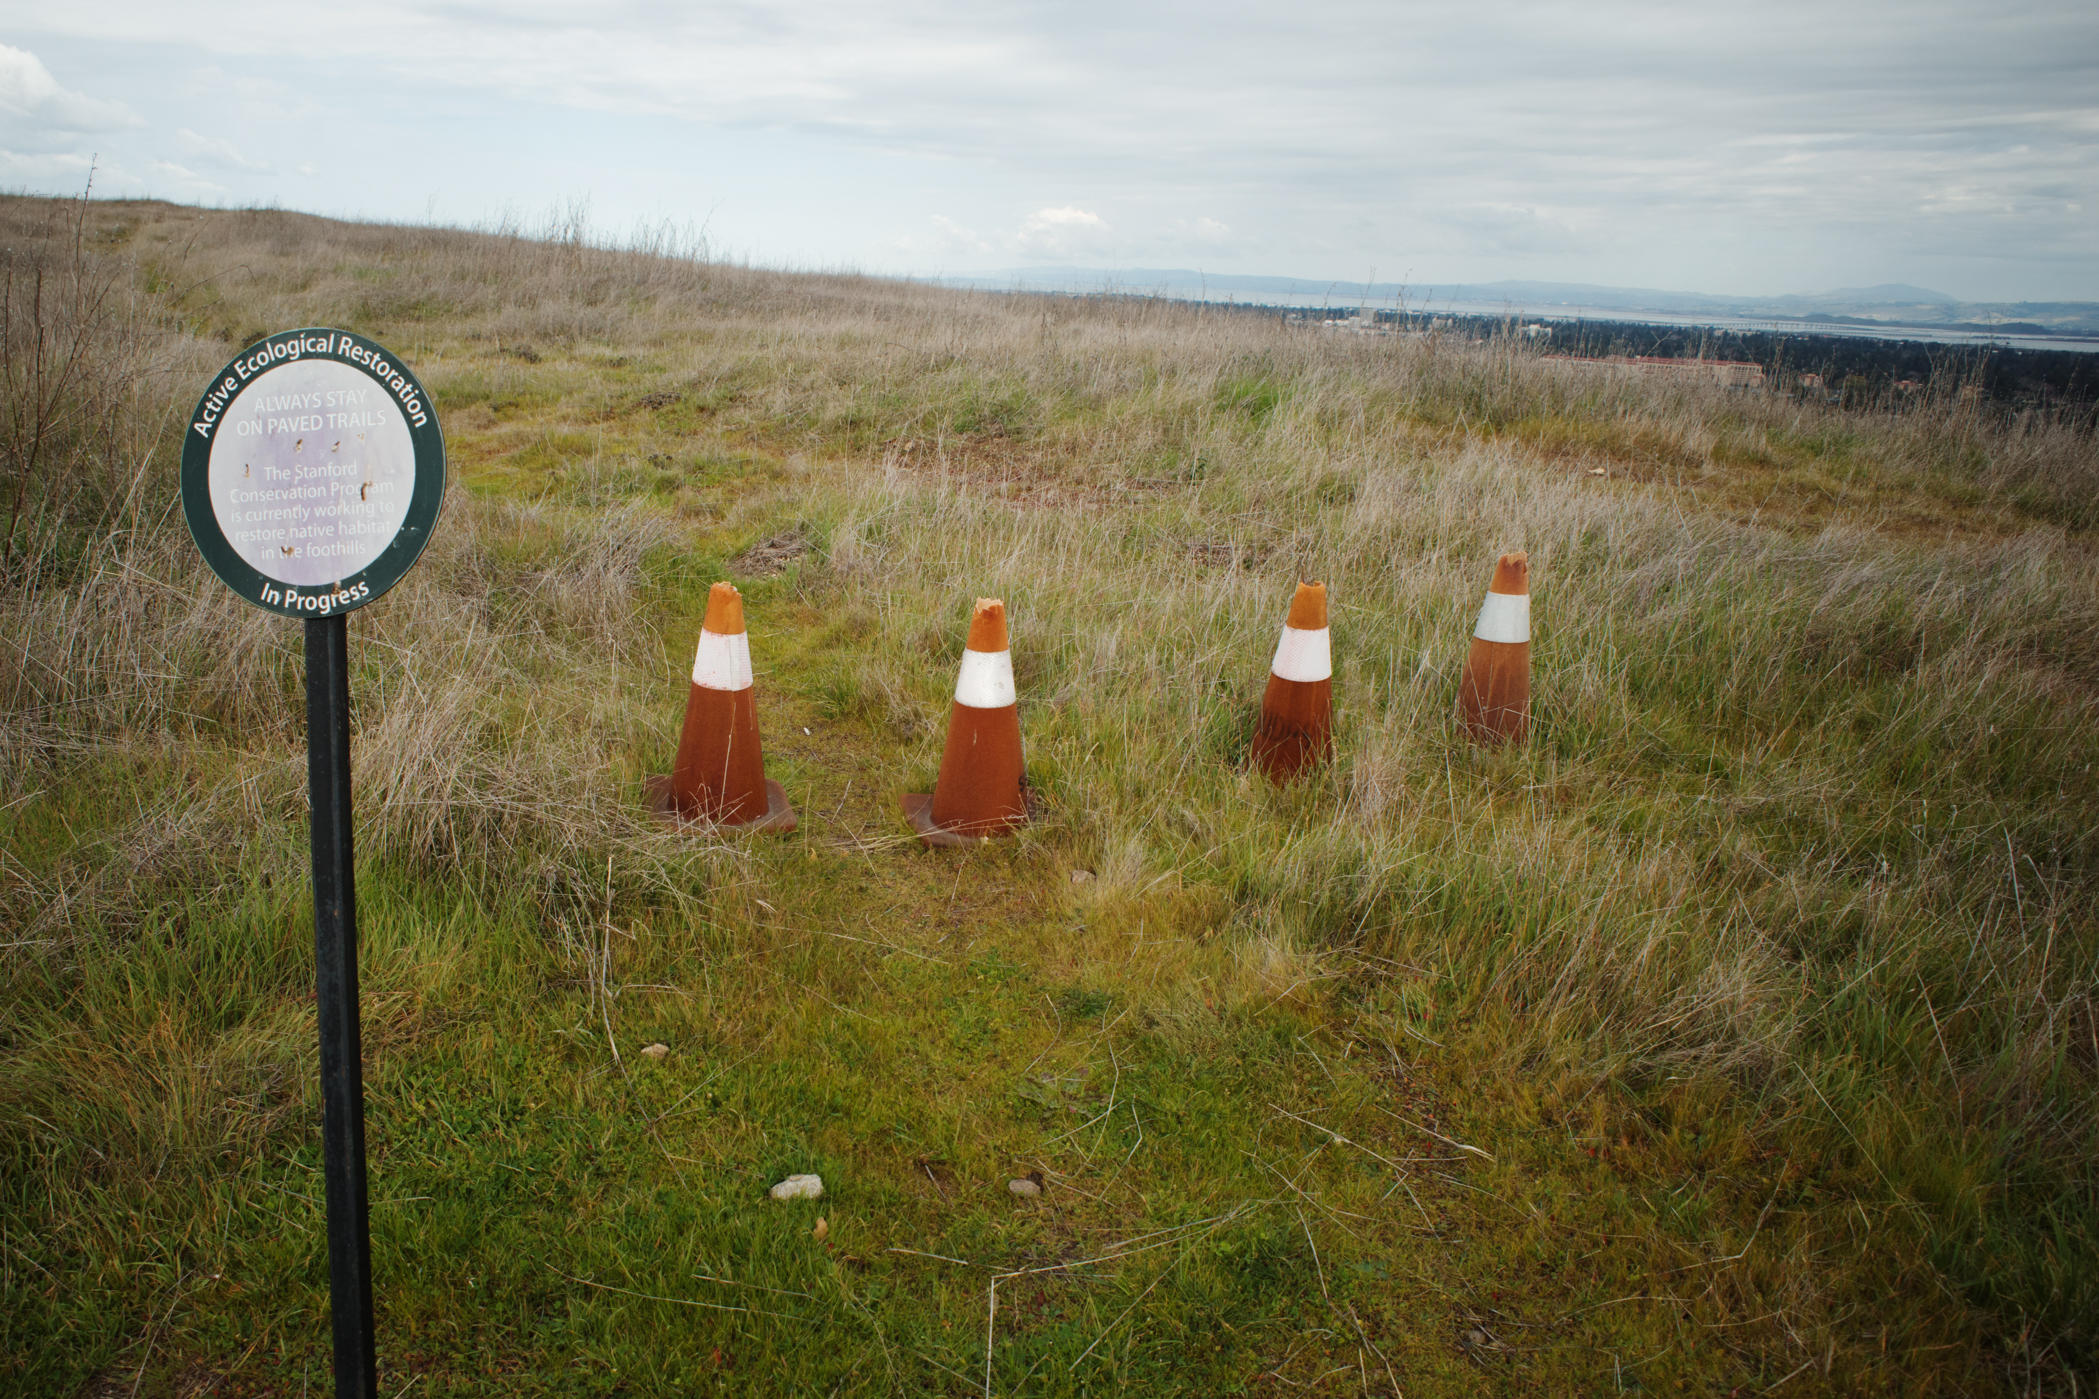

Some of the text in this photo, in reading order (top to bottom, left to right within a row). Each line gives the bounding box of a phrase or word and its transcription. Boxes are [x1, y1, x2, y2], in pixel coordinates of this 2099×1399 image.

[193, 333, 428, 438] Active Ecological Restoration
[254, 389, 367, 412] ALWAYS STAY
[237, 410, 387, 436] ON PAVED TRAILS
[263, 460, 357, 481] The Stanford
[230, 484, 327, 503] Conservation
[231, 501, 395, 523] is currently working to
[235, 519, 391, 542] restore native habitat
[261, 546, 275, 560] in
[306, 540, 366, 558] foothills
[260, 581, 370, 614] In Progress
